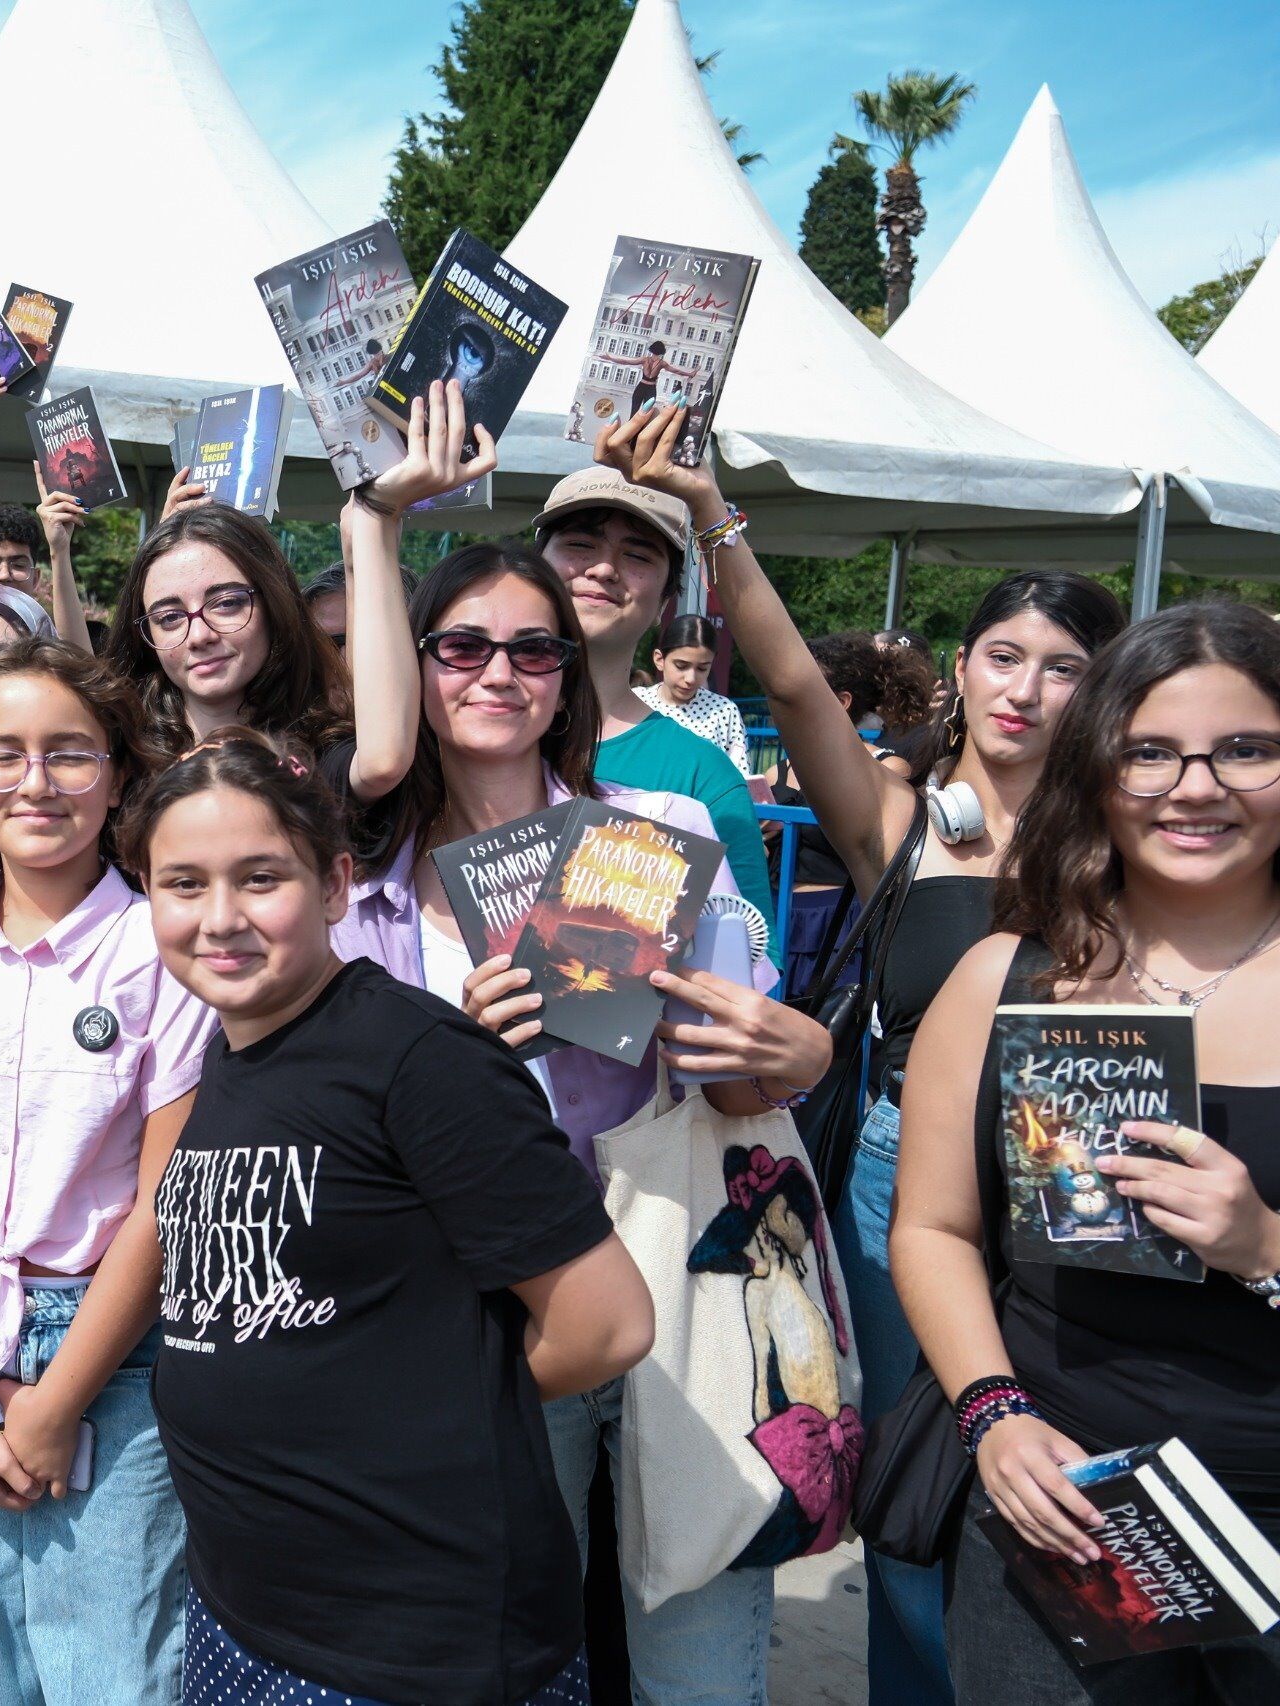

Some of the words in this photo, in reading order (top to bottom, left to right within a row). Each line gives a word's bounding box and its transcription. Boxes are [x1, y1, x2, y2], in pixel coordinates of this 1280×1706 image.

[302, 261, 337, 281] IŞIL
[342, 238, 378, 263] IŞIK
[493, 262, 510, 281] IŞIL
[509, 273, 529, 294] IŞIK
[639, 251, 675, 269] IŞIL
[684, 259, 724, 277] IŞIK
[446, 261, 510, 318] BODRUM
[609, 269, 730, 325] Arden
[46, 344, 54, 352] 2
[36, 404, 89, 442] PARANORMAL
[43, 422, 94, 458] HİKAYELER
[194, 462, 232, 480] BEYAZ
[579, 483, 656, 503] NOWADAYS
[469, 838, 505, 858] IŞIL
[509, 822, 547, 844] IŞIK
[605, 817, 641, 839] IŞIL
[648, 832, 688, 854] IŞIK
[572, 825, 692, 897] PARANORMAL
[567, 866, 676, 940] HİKAYELER
[660, 933, 679, 952] 2
[1040, 1029, 1088, 1048] IŞIL
[1097, 1030, 1148, 1049] IŞIK
[1018, 1053, 1166, 1092] KARDAN
[1036, 1088, 1169, 1124] ADAMIN
[192, 1272, 232, 1340] of
[233, 1276, 336, 1343] office
[1100, 1502, 1214, 1622] PARANORMAL
